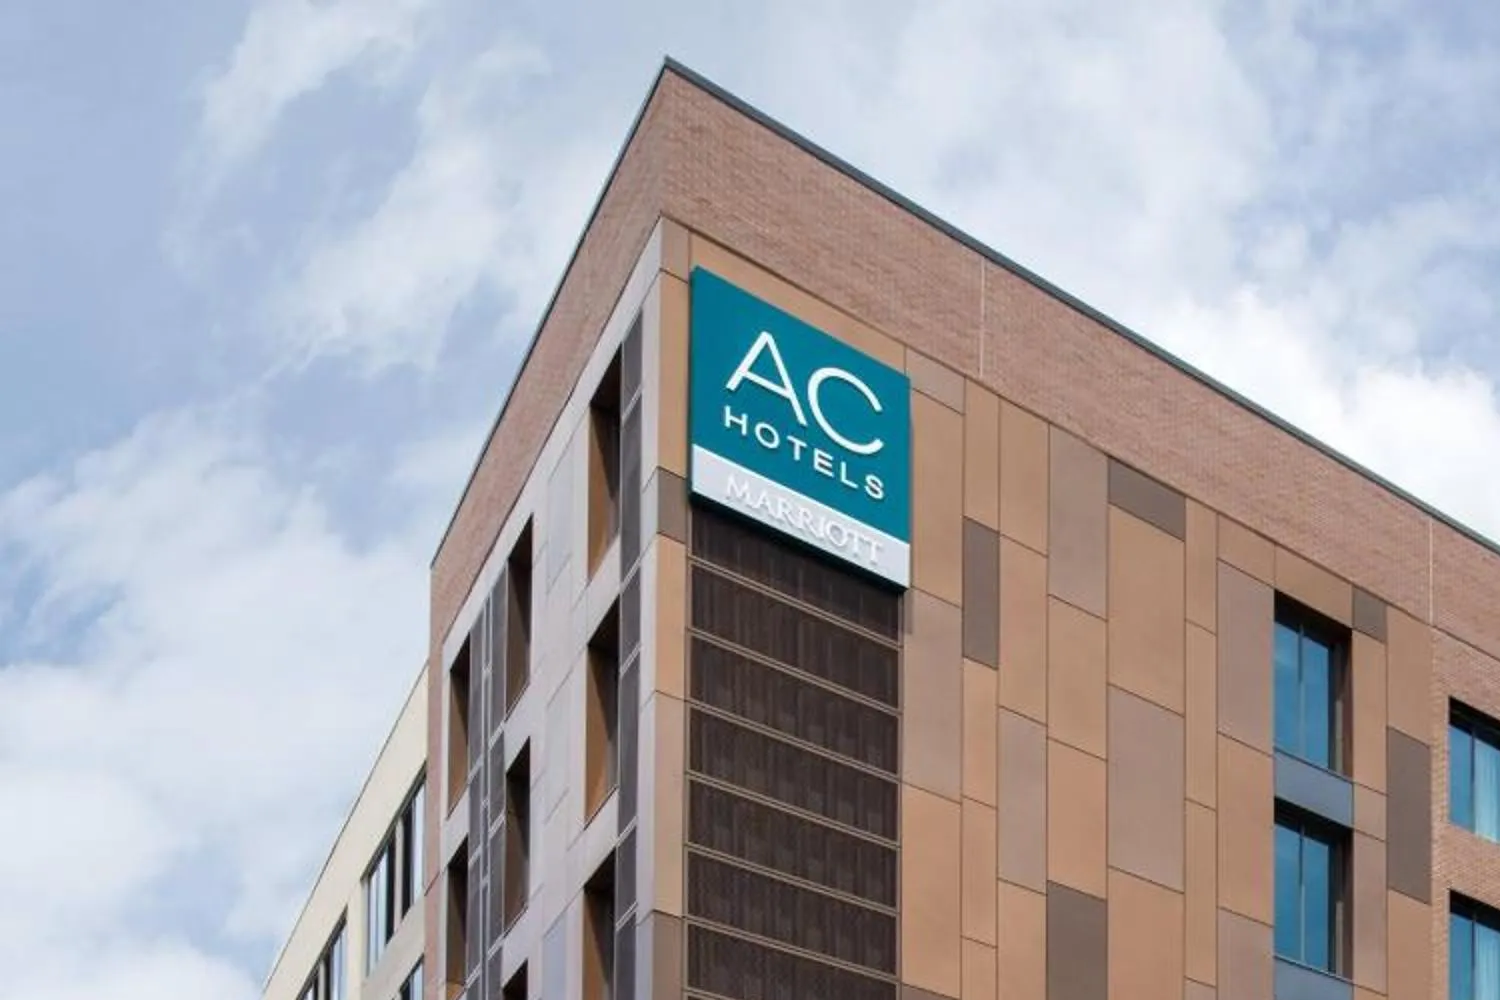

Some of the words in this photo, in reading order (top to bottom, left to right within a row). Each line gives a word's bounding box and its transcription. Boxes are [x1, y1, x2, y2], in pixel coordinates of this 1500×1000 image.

[725, 330, 884, 455] AC
[723, 404, 885, 500] HOTELS
[726, 474, 883, 564] MARRIOTT
